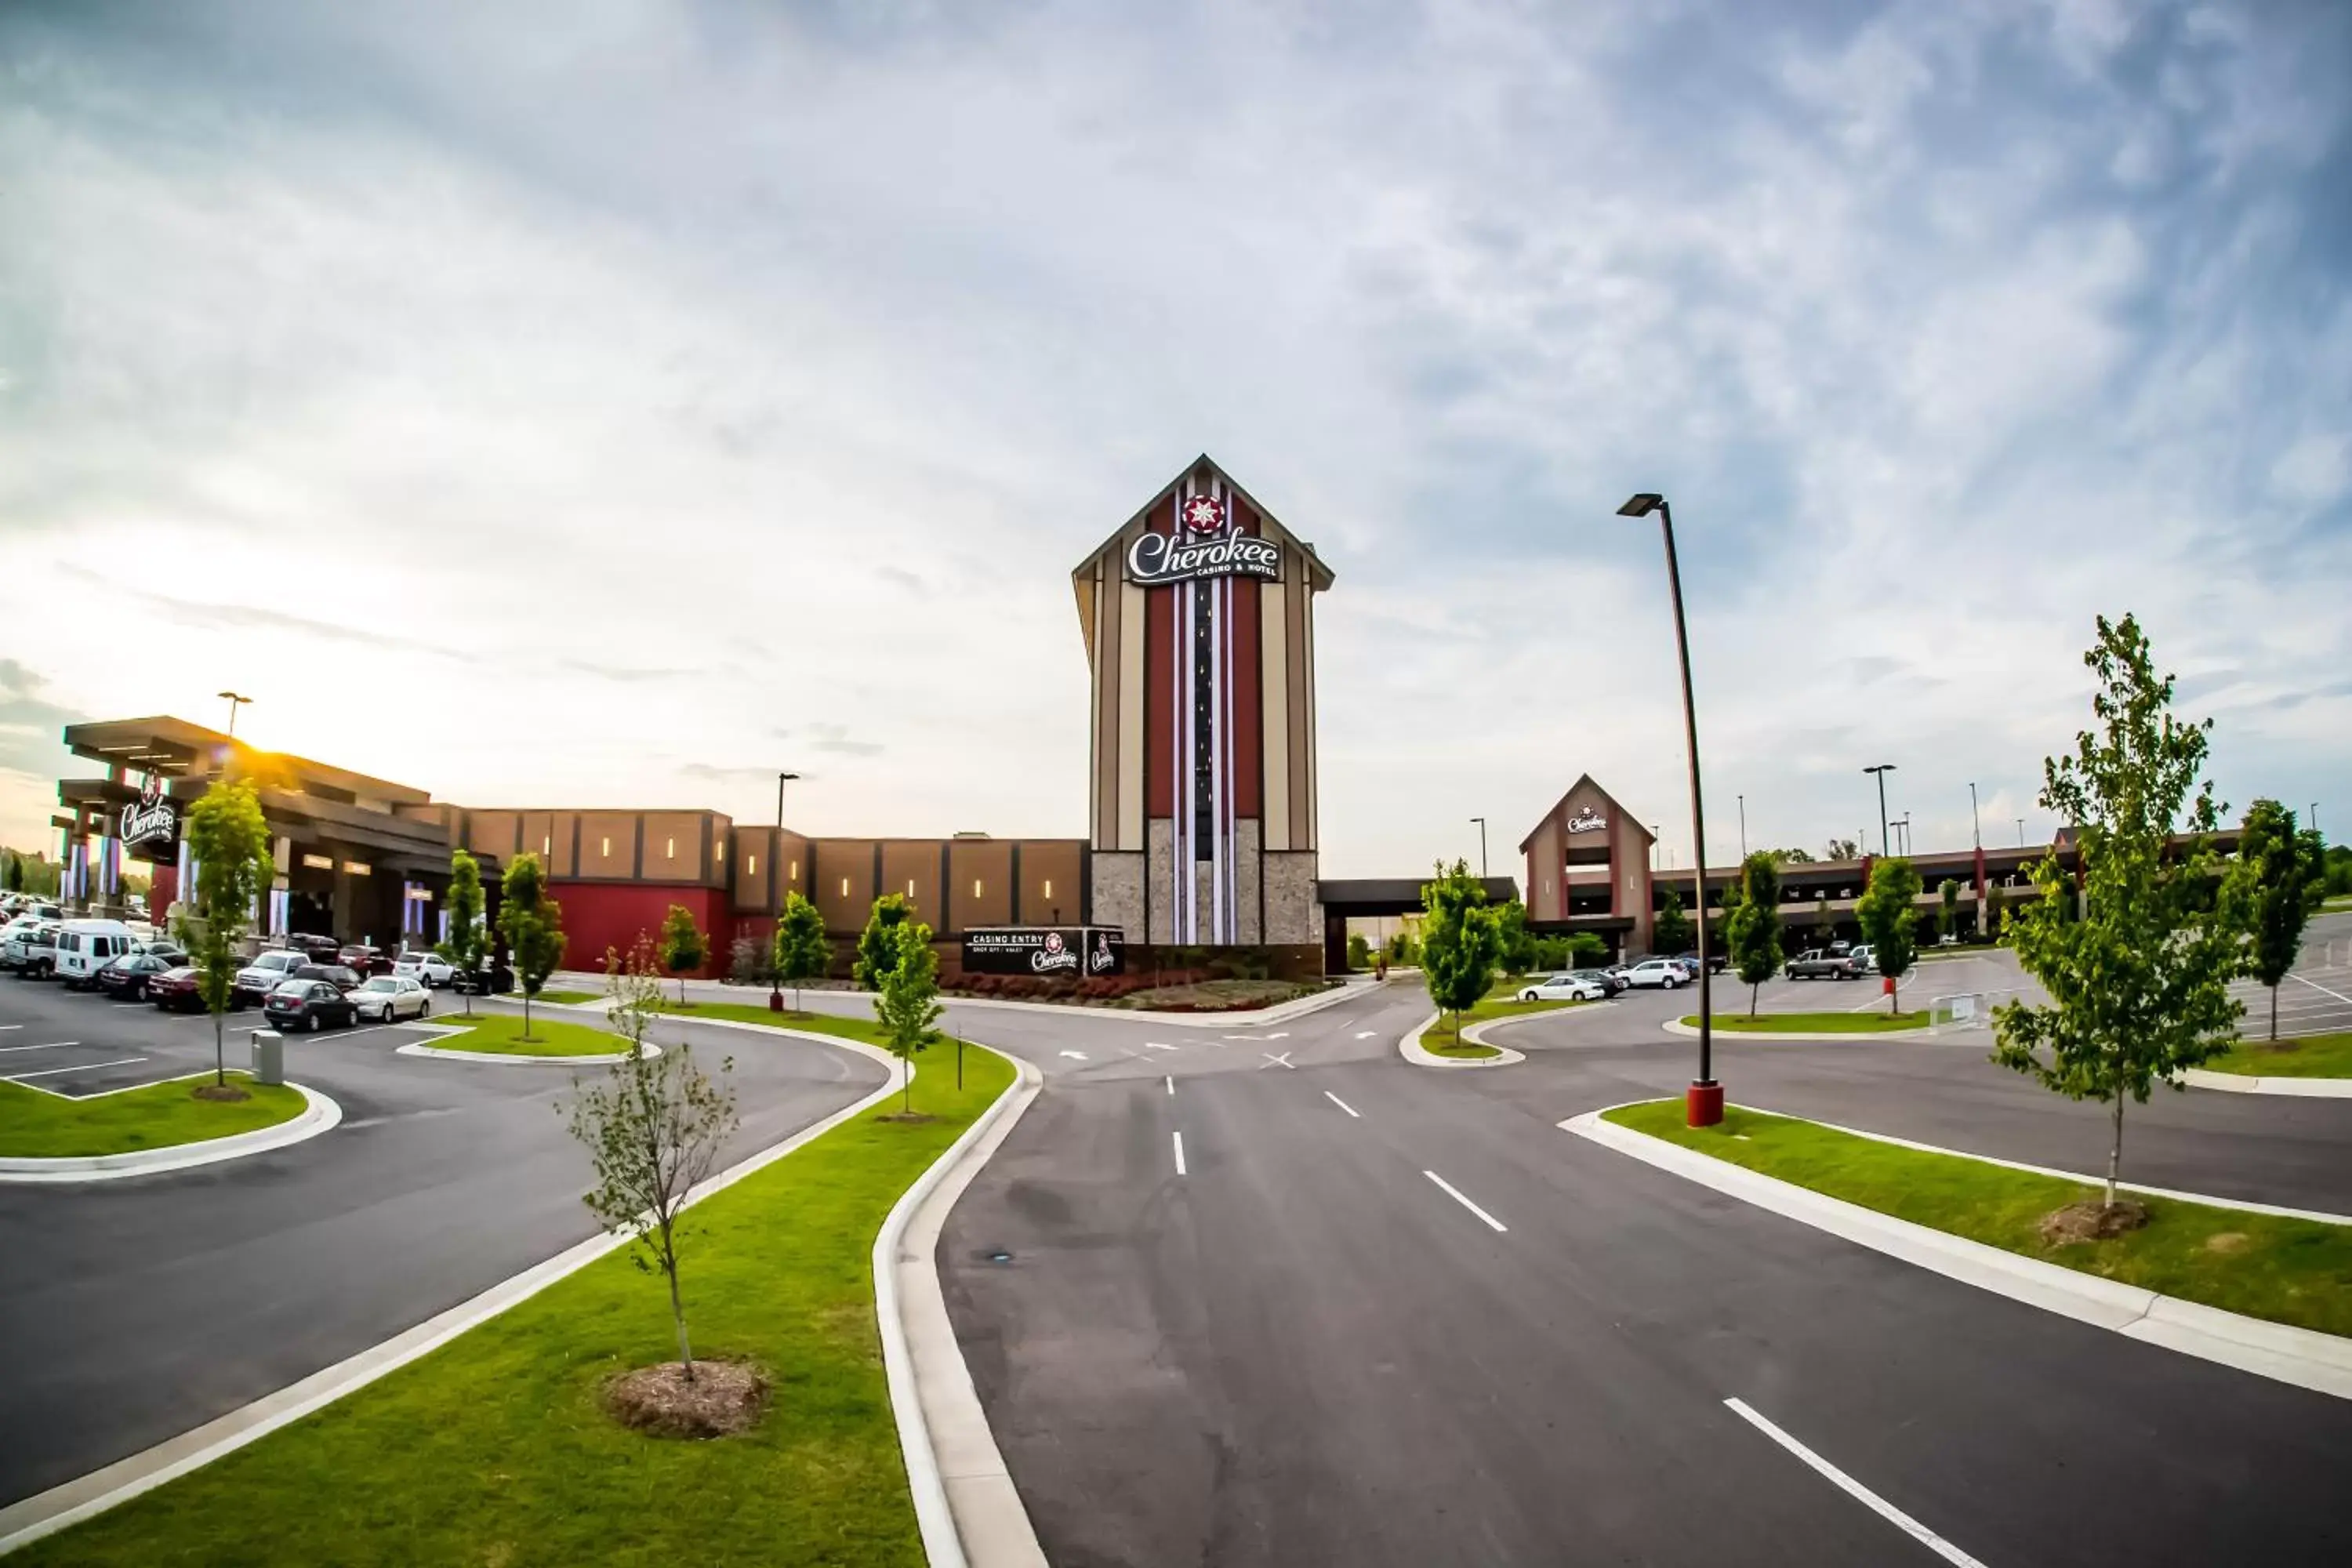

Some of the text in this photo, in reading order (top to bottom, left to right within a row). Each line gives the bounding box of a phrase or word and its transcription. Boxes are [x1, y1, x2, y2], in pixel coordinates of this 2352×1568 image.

[1129, 527, 1278, 577] Cherokee
[1196, 563, 1277, 576] CASINO & HOTEL
[121, 794, 174, 841] Cherokee
[973, 935, 1044, 943] CASINO ENTRY
